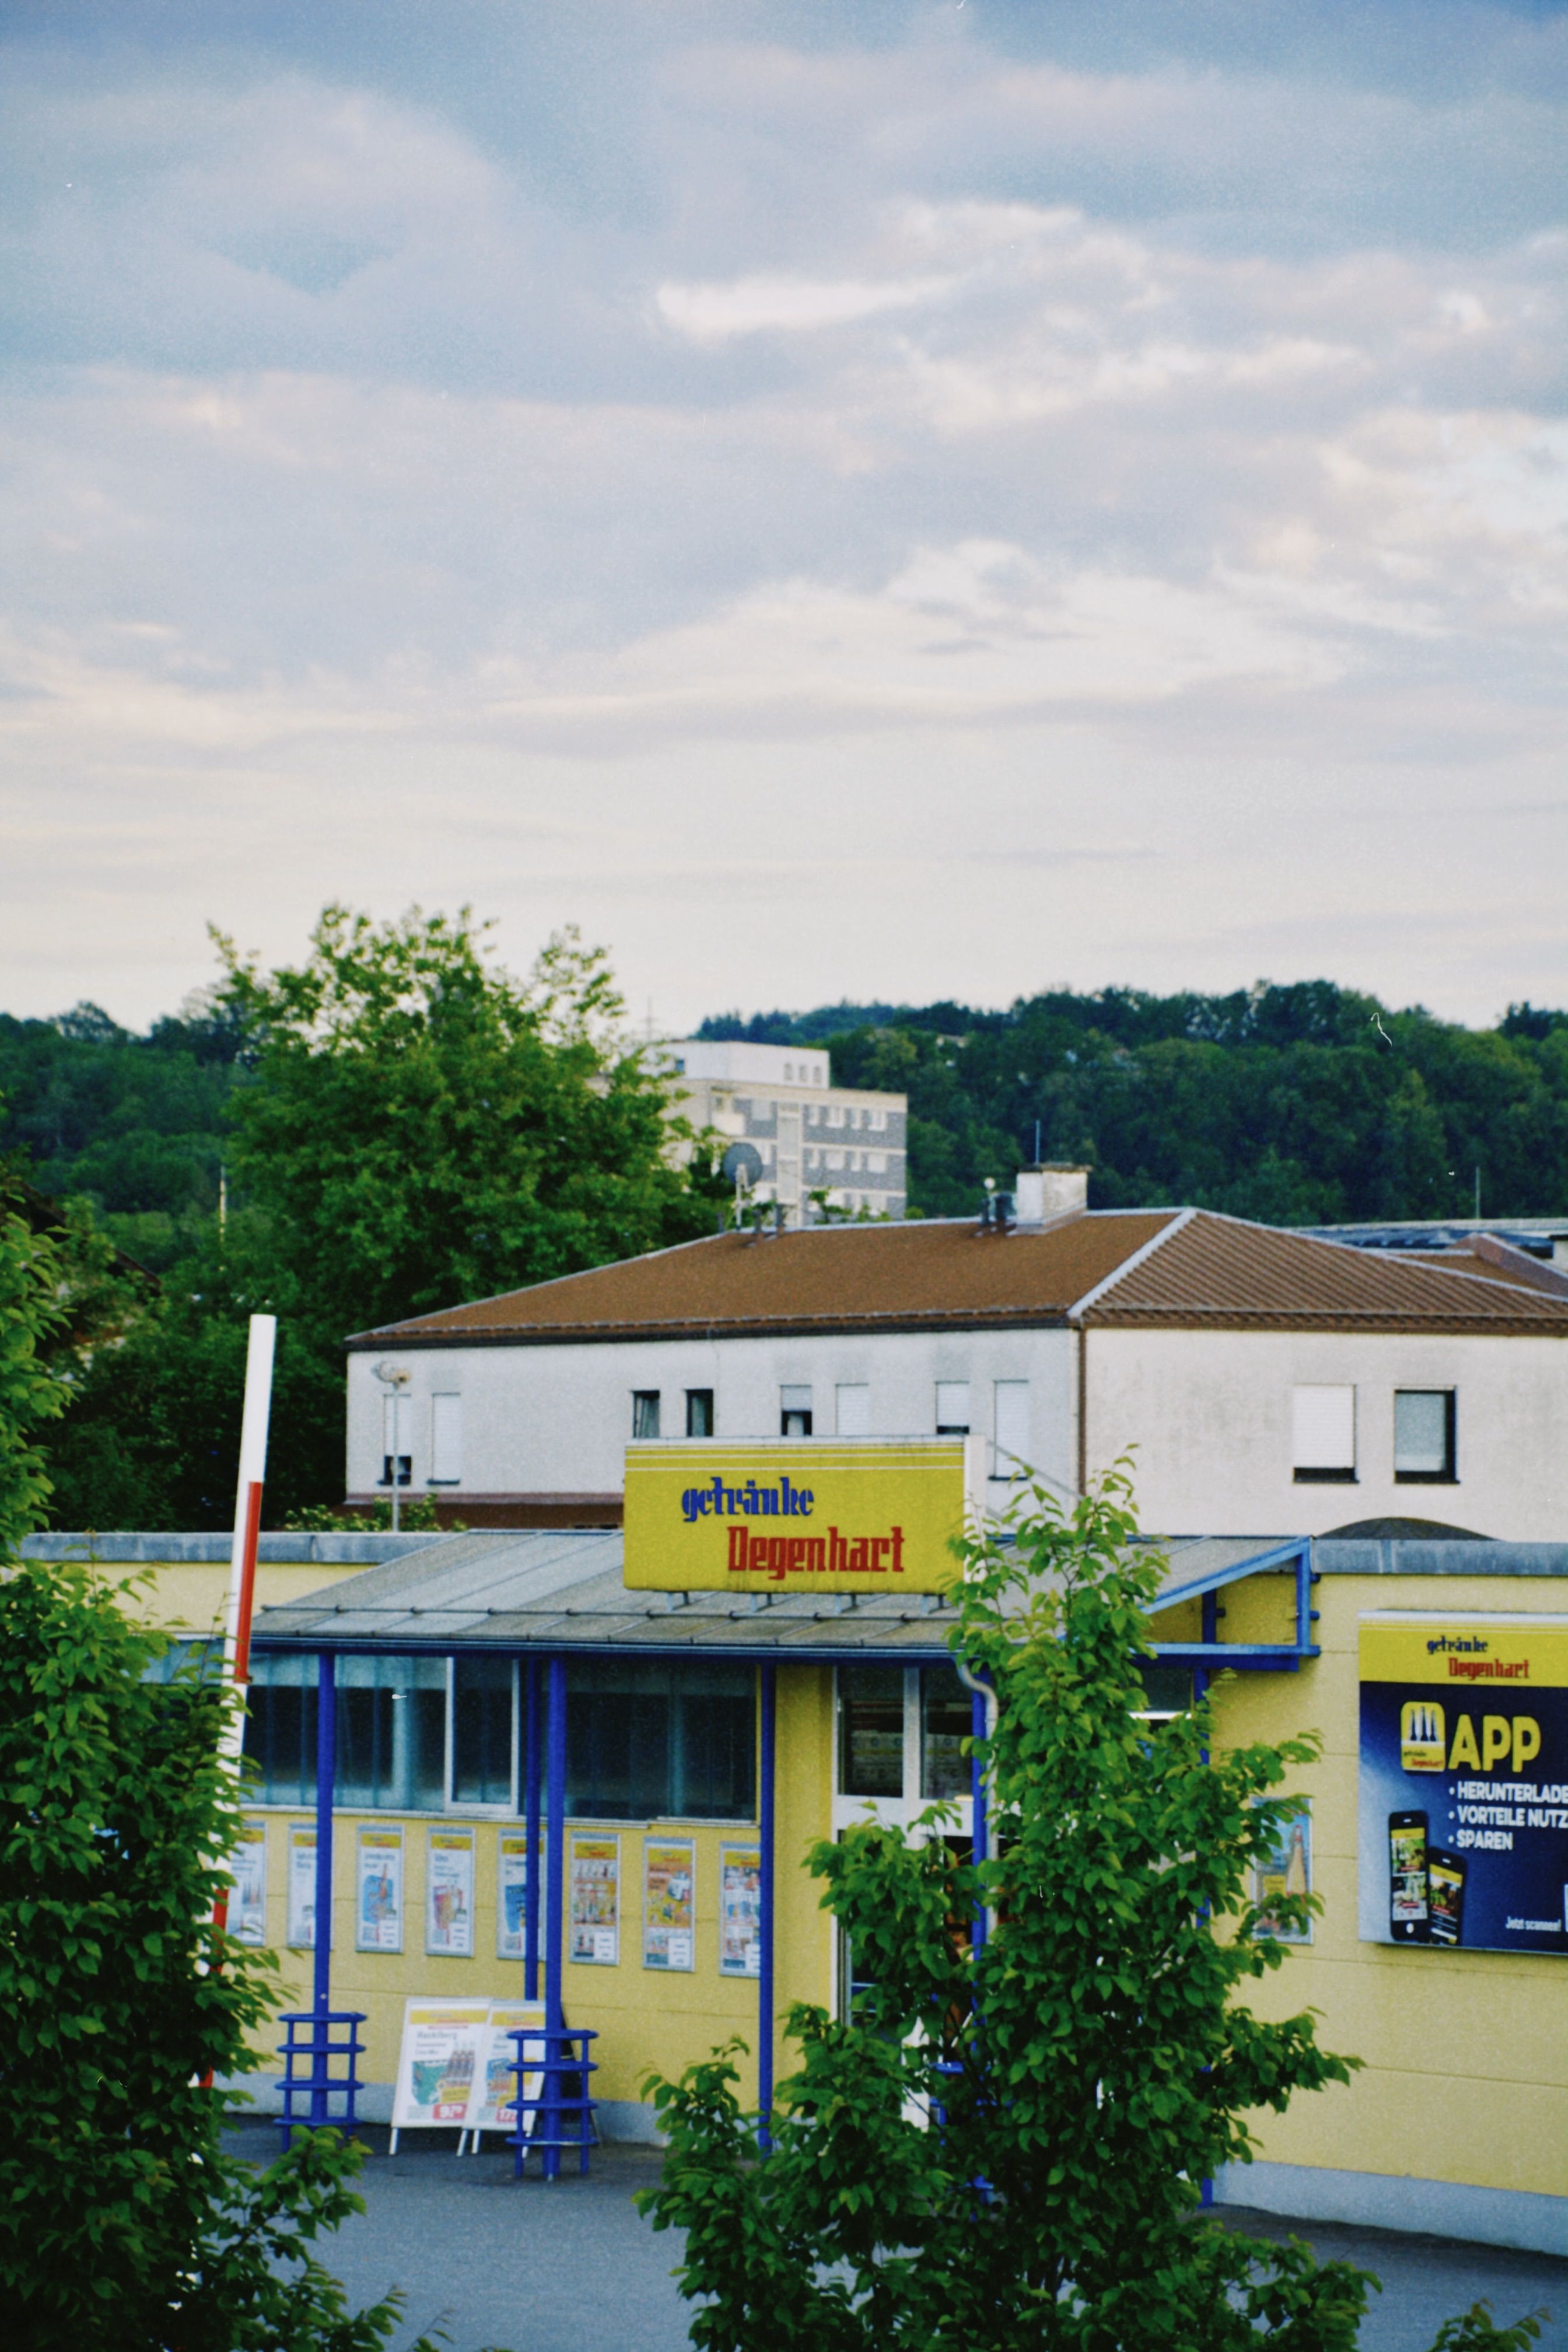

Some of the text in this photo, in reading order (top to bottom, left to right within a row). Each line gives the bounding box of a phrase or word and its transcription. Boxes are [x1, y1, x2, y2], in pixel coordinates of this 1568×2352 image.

[682, 1476, 814, 1522] getränke
[727, 1526, 905, 1580] Degenhart
[1427, 1636, 1488, 1654] getränke
[1448, 1657, 1529, 1681] Degenhart
[1448, 1714, 1541, 1773] APP
[1458, 1781, 1568, 1804] HERUNTERLADE
[1457, 1805, 1568, 1828] VORTEILE NUTZ
[1457, 1829, 1513, 1850] SPAREN
